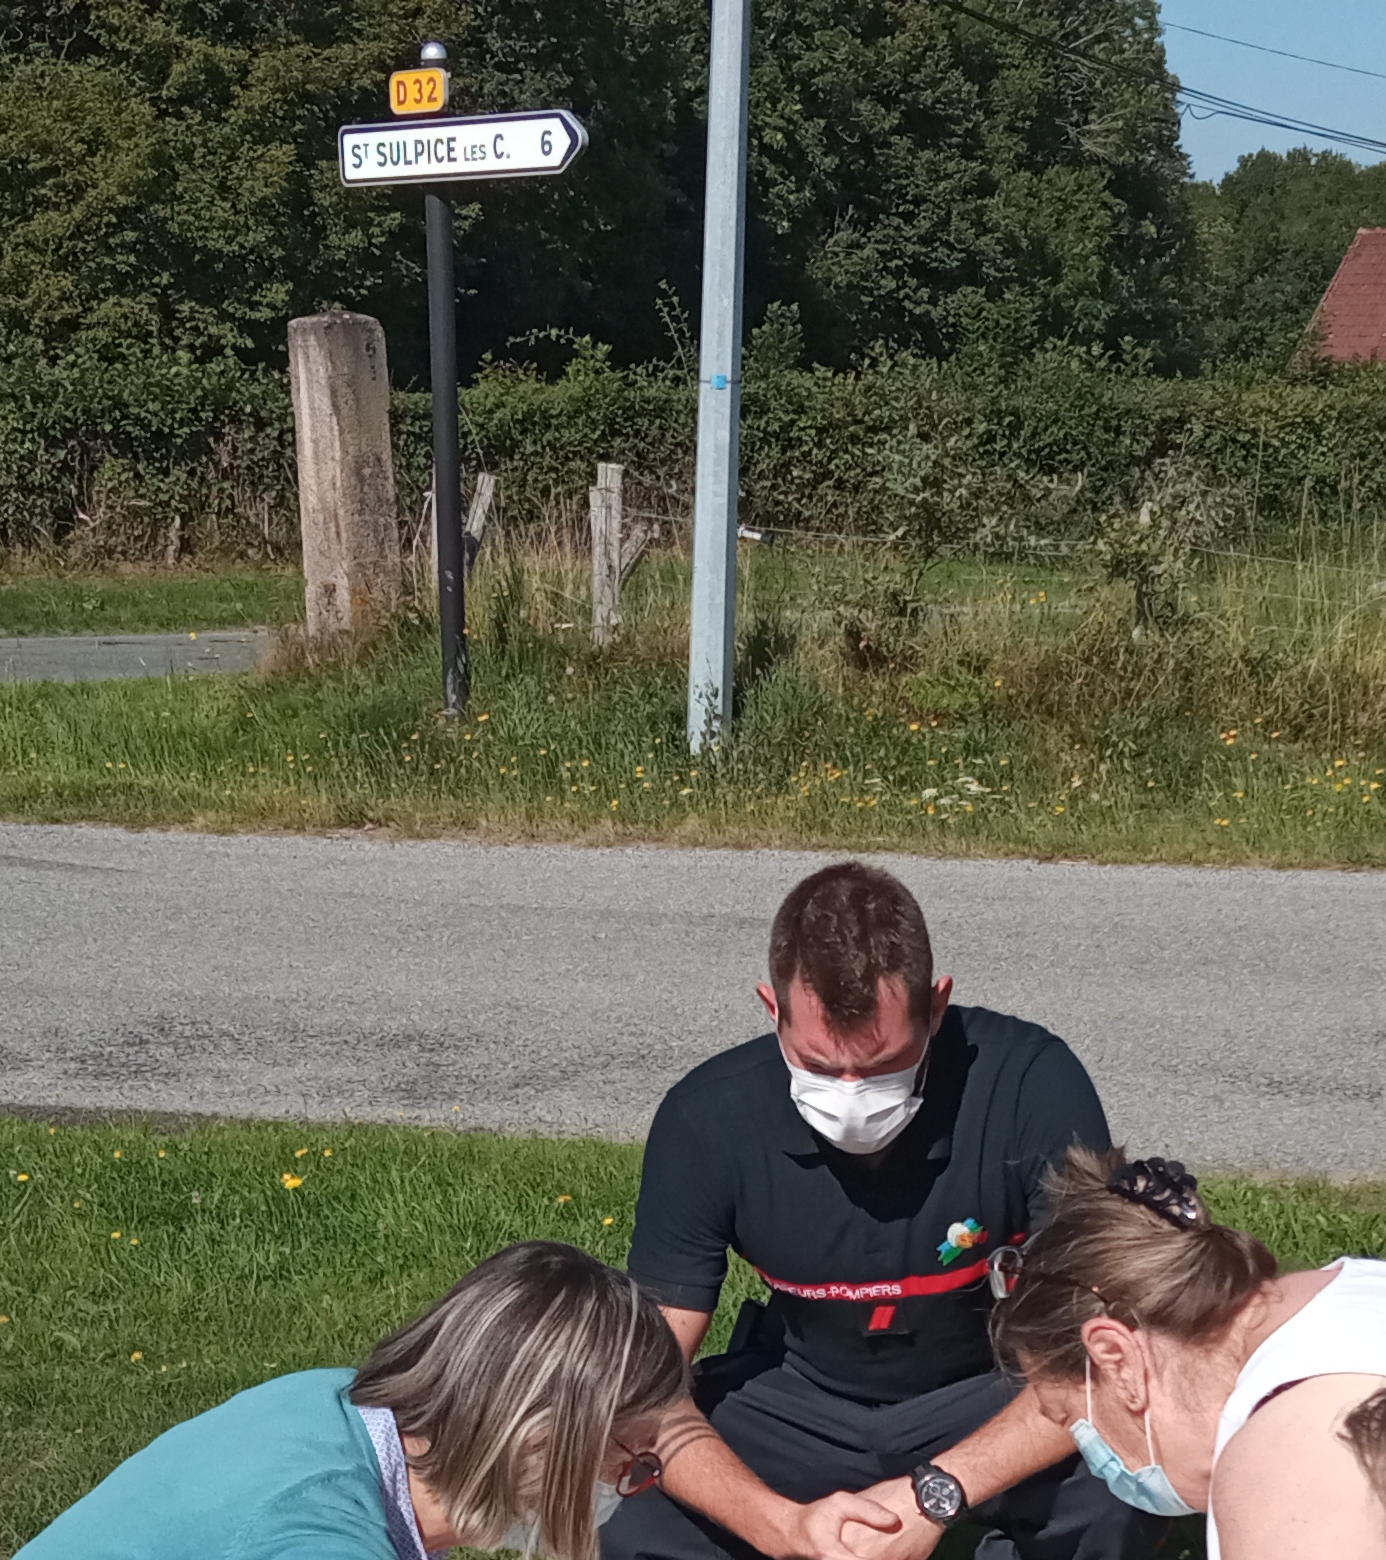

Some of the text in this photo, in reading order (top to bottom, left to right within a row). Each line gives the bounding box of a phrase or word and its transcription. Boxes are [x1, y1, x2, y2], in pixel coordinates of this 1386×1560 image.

[395, 76, 438, 106] D 32
[376, 136, 457, 167] SULPICE
[463, 143, 487, 161] LES
[492, 133, 511, 160] C.
[540, 129, 553, 157] 6
